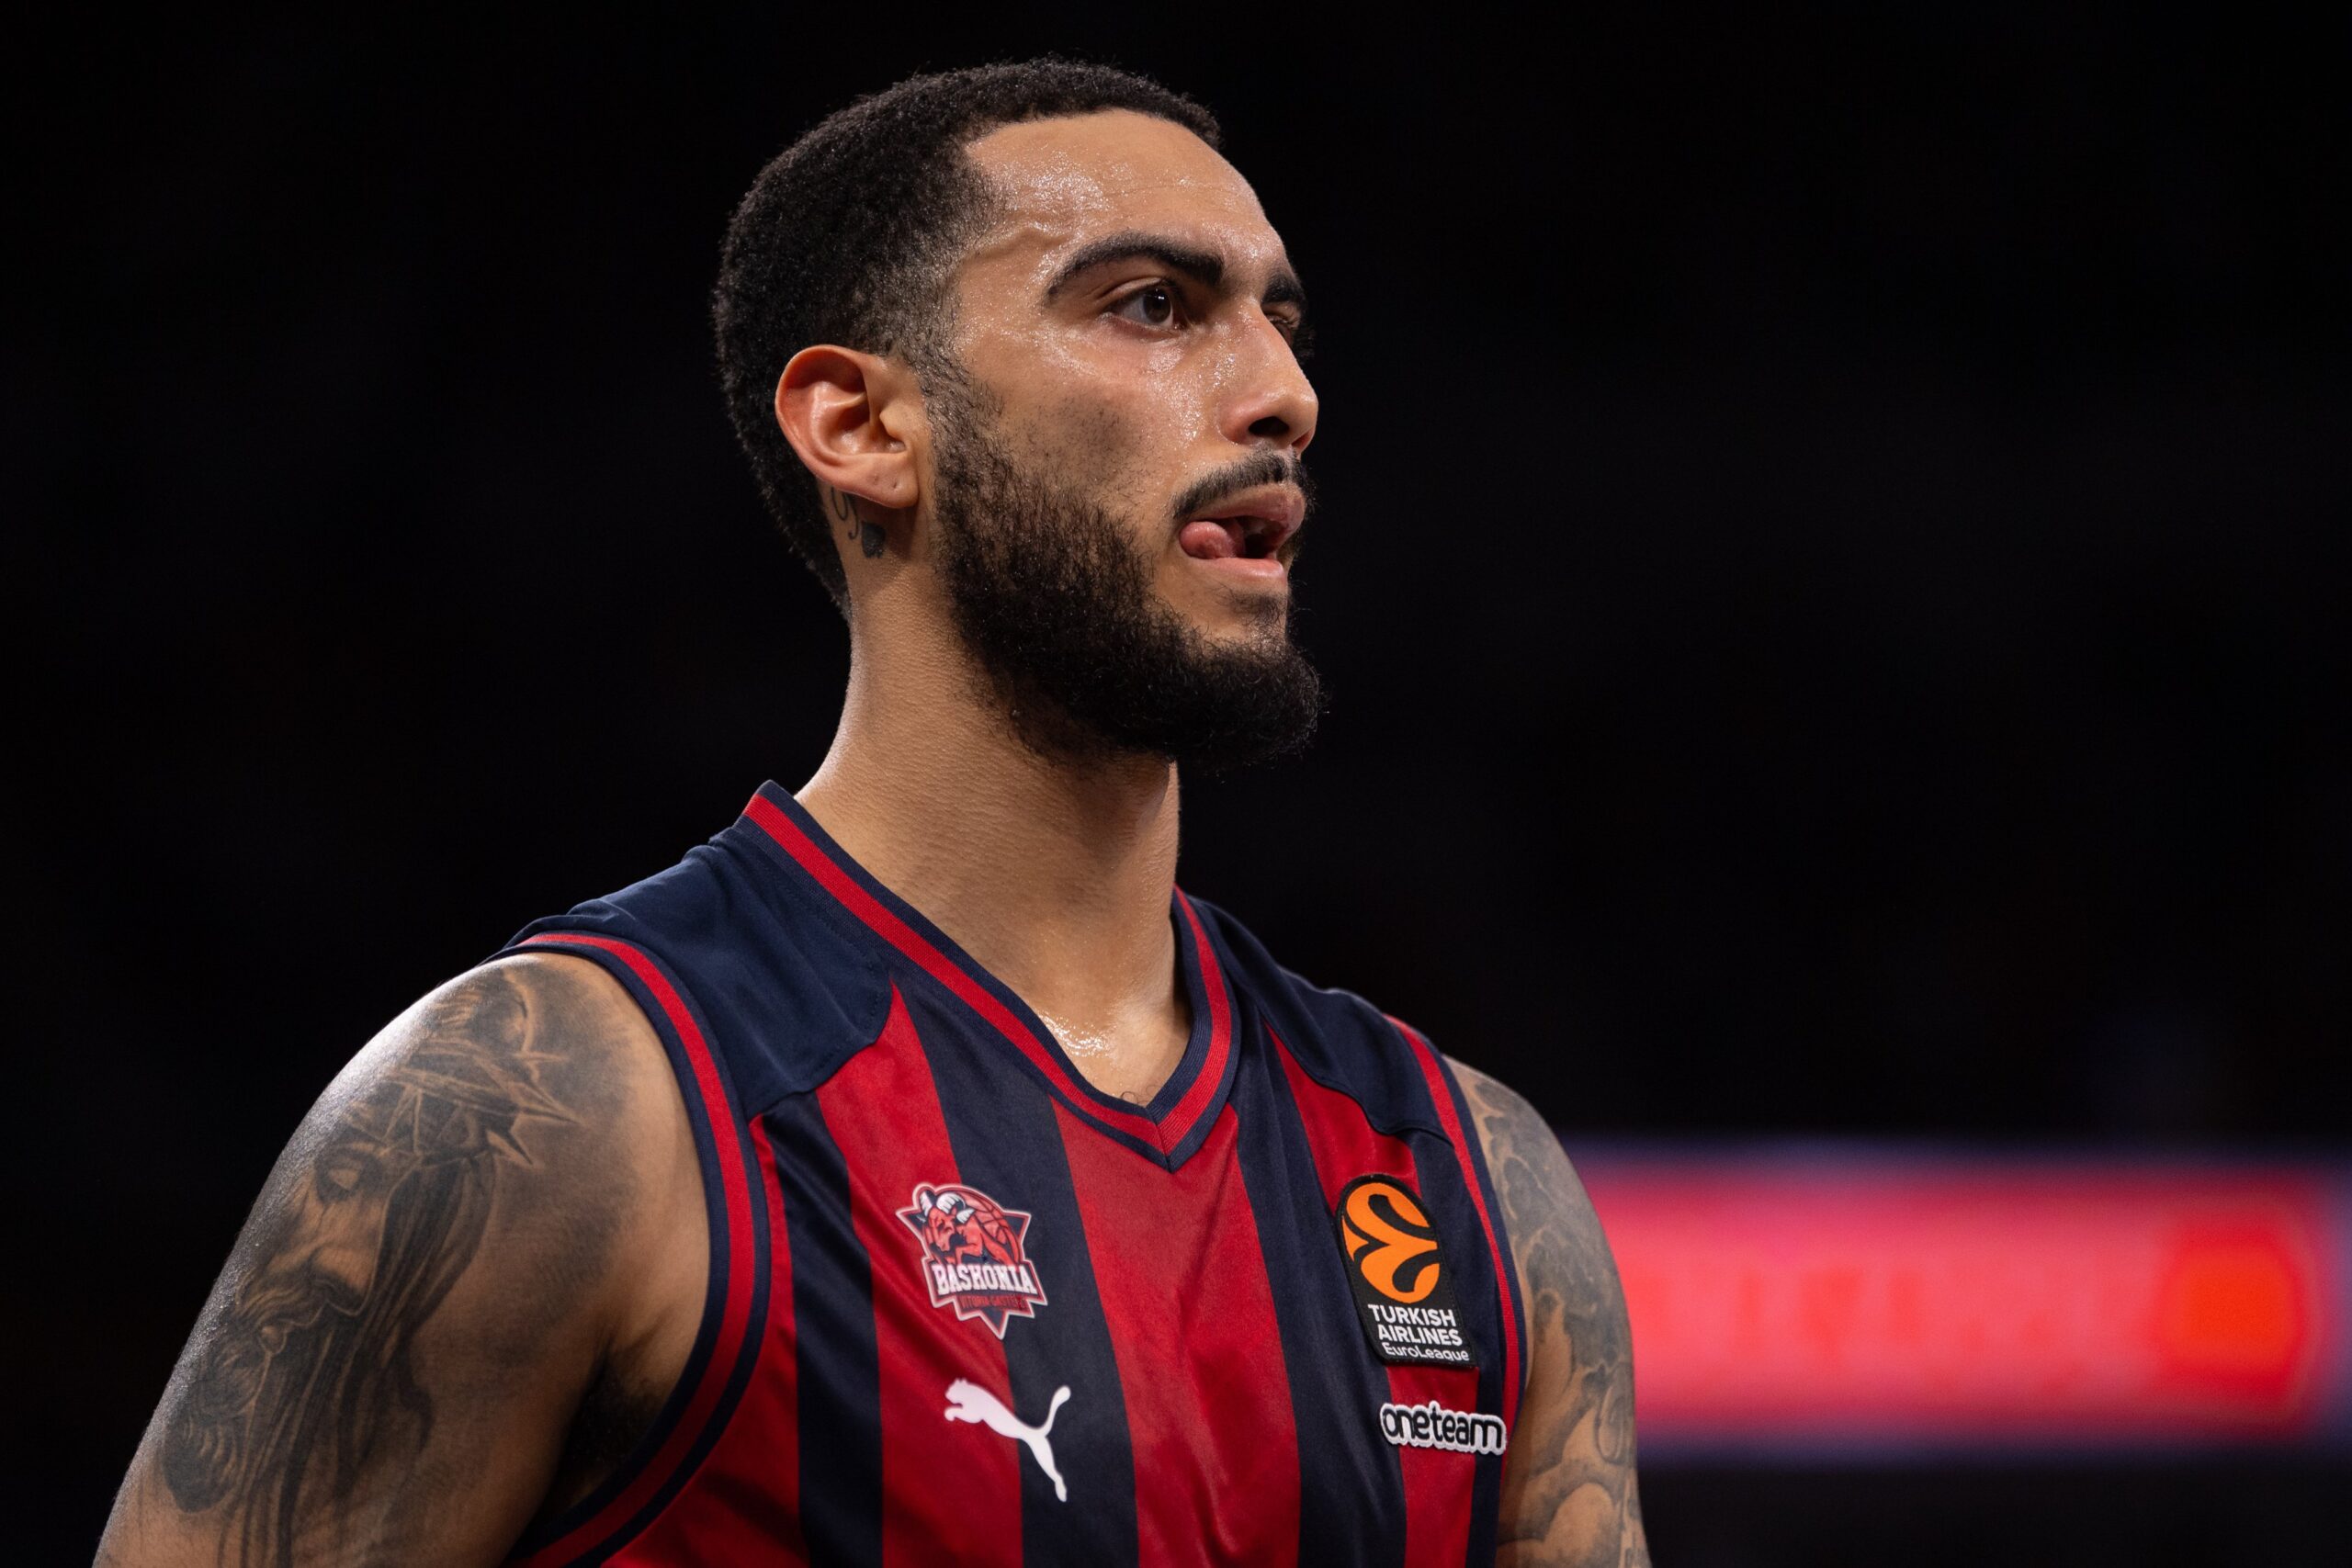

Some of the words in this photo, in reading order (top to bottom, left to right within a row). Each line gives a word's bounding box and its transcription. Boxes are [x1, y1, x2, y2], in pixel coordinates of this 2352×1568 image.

[1367, 1304, 1456, 1327] TURKISH
[1378, 1325, 1463, 1346] AIRLINES
[1381, 1342, 1469, 1361] EuroLeague
[1382, 1405, 1502, 1449] oneteam
